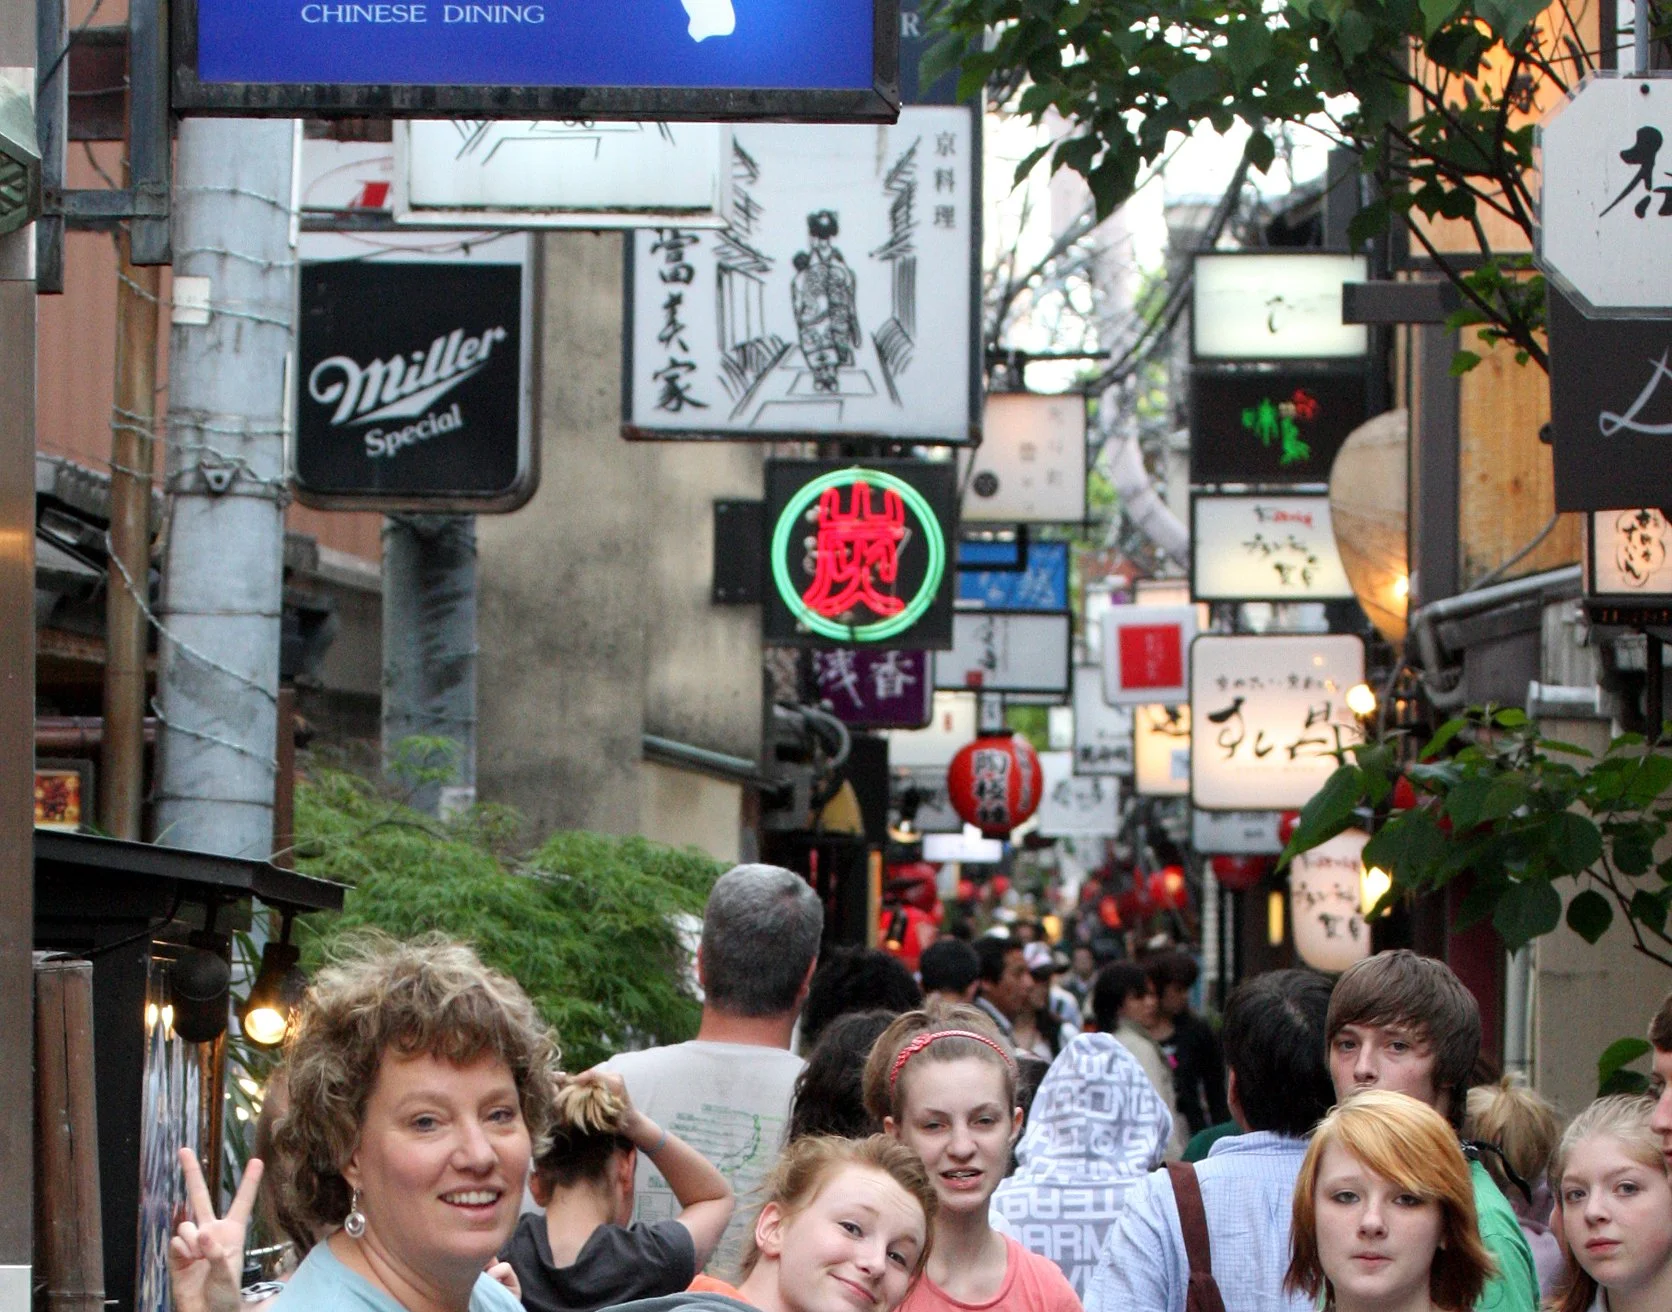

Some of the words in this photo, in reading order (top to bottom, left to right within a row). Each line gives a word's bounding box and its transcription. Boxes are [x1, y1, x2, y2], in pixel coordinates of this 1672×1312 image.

[301, 4, 427, 24] CHINESE
[443, 4, 545, 24] DINING
[933, 131, 957, 231] 京料理
[309, 325, 507, 425] Miller
[364, 403, 463, 458] Special
